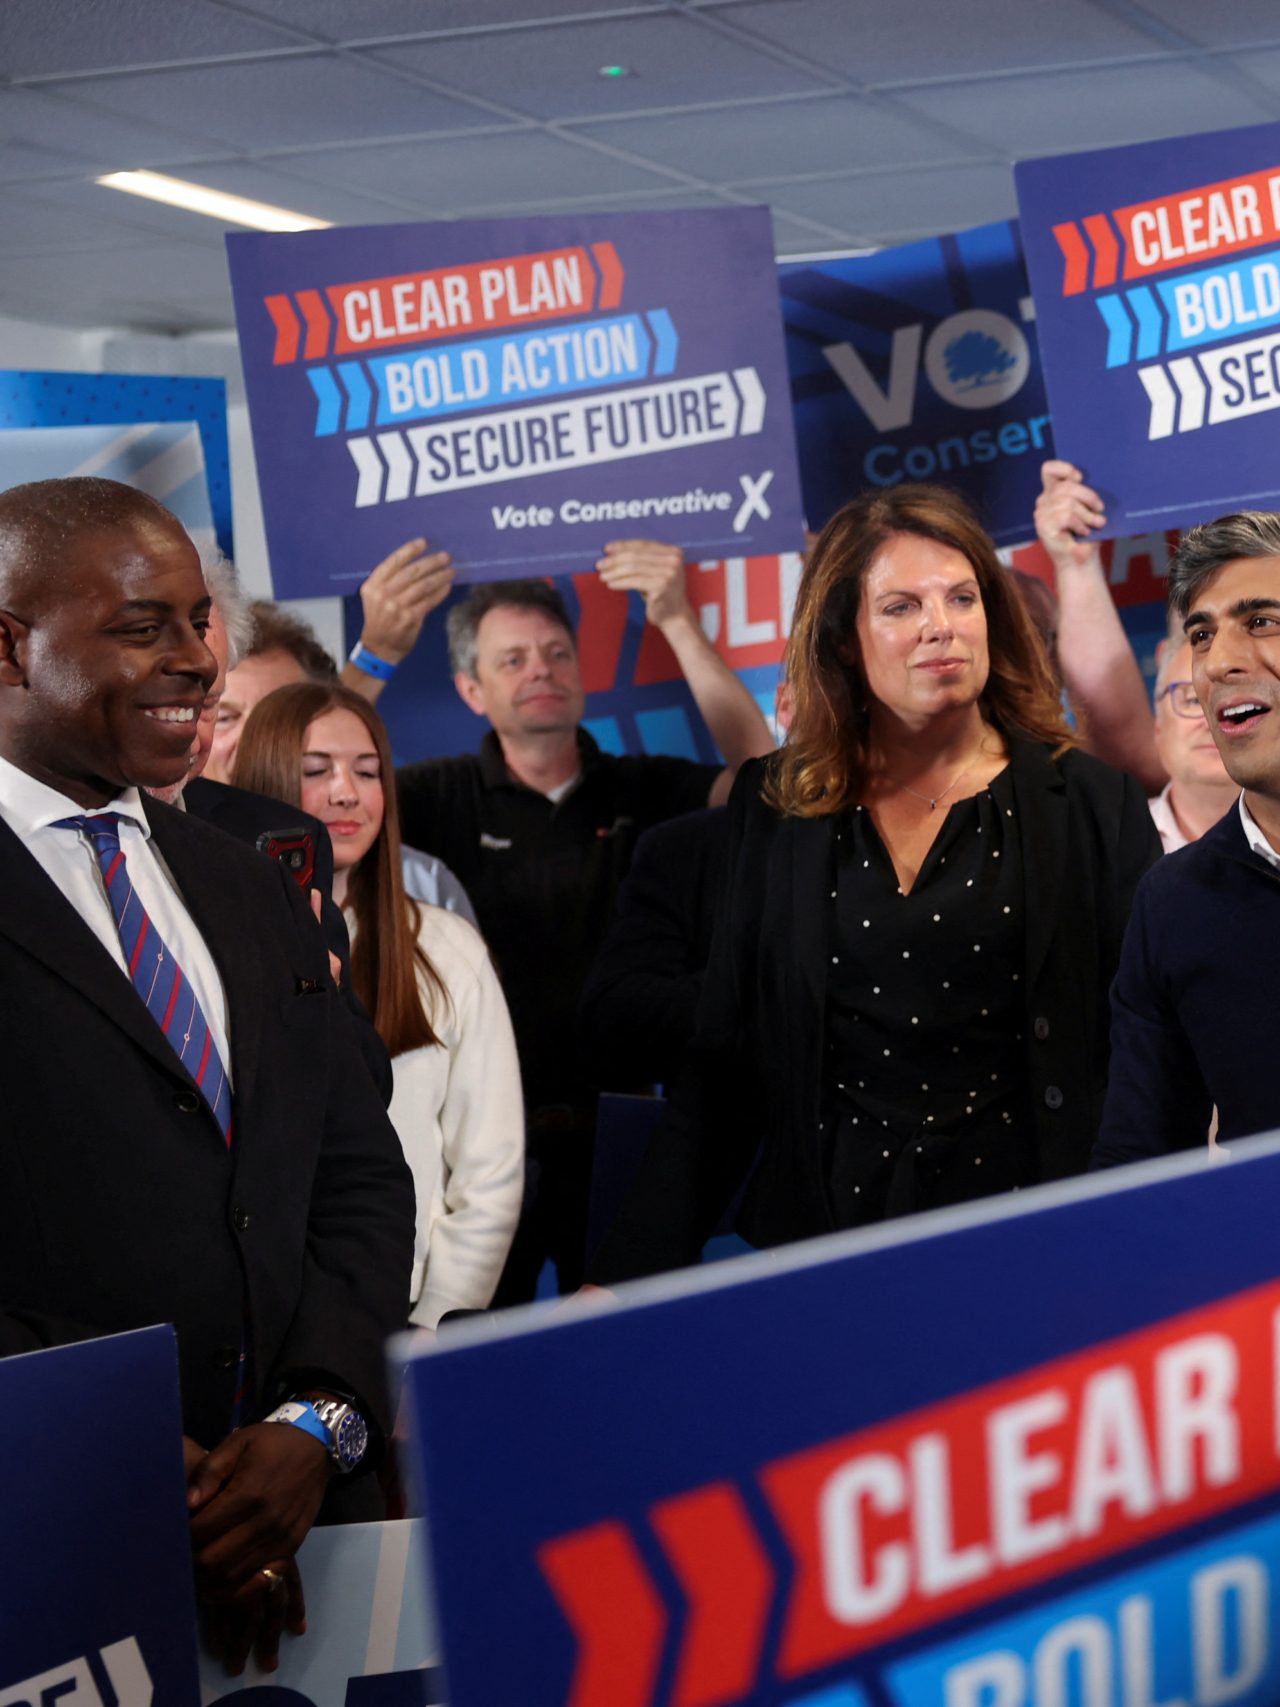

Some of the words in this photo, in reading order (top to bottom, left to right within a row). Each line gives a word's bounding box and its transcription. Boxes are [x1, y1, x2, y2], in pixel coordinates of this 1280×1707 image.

[1131, 185, 1263, 266] CLEAR
[343, 275, 473, 343] CLEAR
[480, 256, 583, 320] PLAN
[385, 350, 489, 413] BOLD
[502, 323, 638, 393] ACTION
[427, 411, 575, 481] SECURE
[584, 384, 726, 453] FUTURE
[863, 414, 1053, 486] Conser
[491, 504, 554, 530] Vote
[560, 488, 732, 524] Conservative
[820, 1332, 1240, 1625] CLEAR
